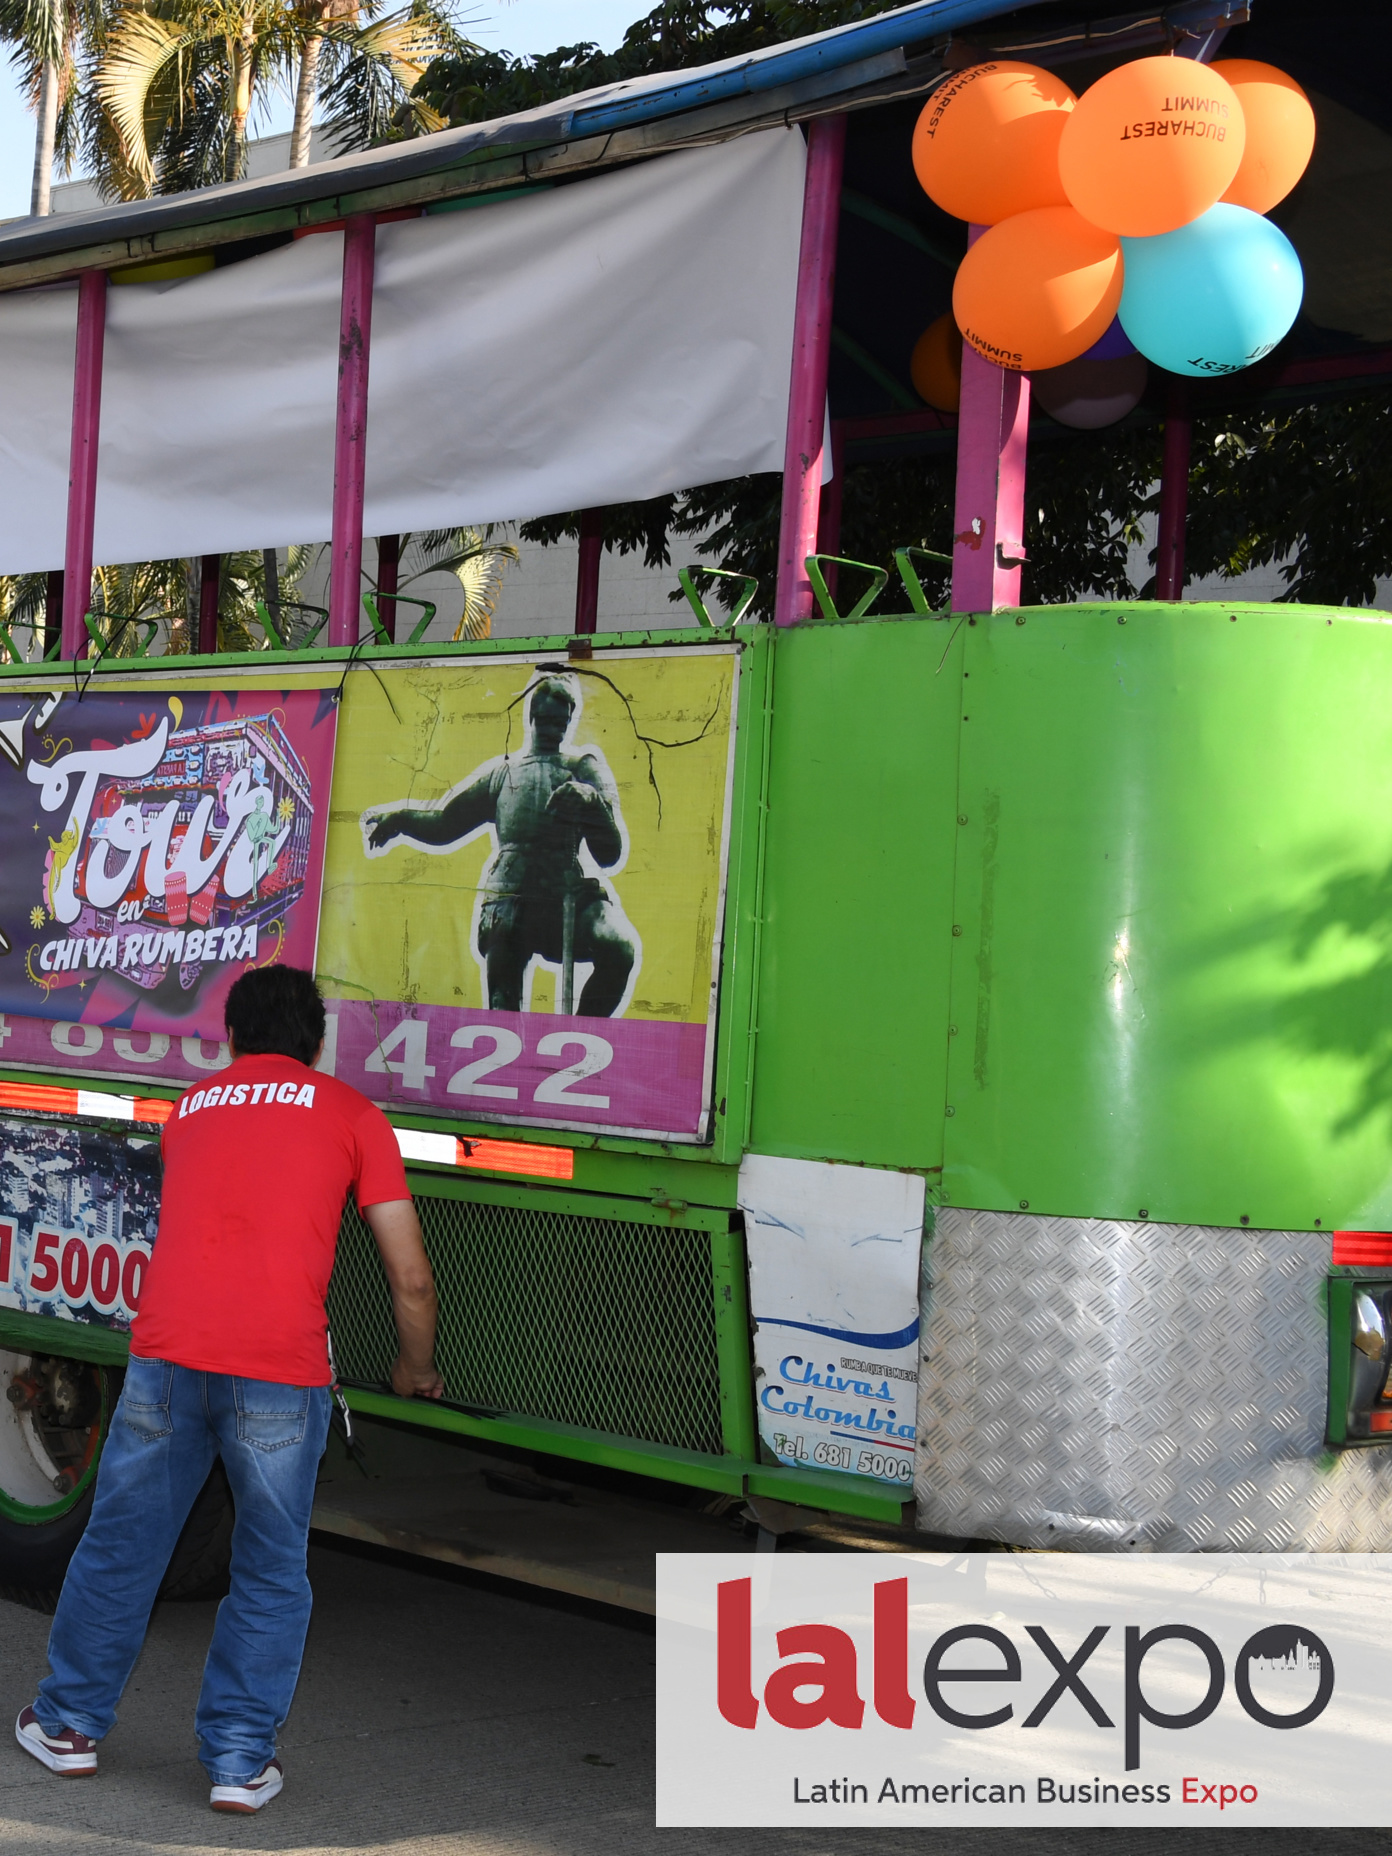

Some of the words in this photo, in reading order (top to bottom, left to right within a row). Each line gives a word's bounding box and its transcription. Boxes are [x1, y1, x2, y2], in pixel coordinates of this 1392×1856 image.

[927, 64, 997, 139] BUCHAREST
[1161, 97, 1230, 119] SUMMIT
[1120, 120, 1227, 142] BUCHAREST
[964, 328, 1023, 362] SUMMIT
[117, 898, 150, 923] en
[39, 937, 117, 971] CHIVA
[121, 924, 258, 969] RUMBERA
[178, 1082, 316, 1120] LOGISTICA
[30, 1231, 153, 1313] 5000
[779, 1355, 896, 1403] Chivas
[840, 1356, 868, 1373] RUMBA
[867, 1365, 884, 1377] QUE
[883, 1365, 893, 1378] TE
[761, 1385, 916, 1442] Colombia
[773, 1433, 809, 1461] Tel.
[813, 1442, 852, 1469] 681
[857, 1451, 912, 1482] 5000
